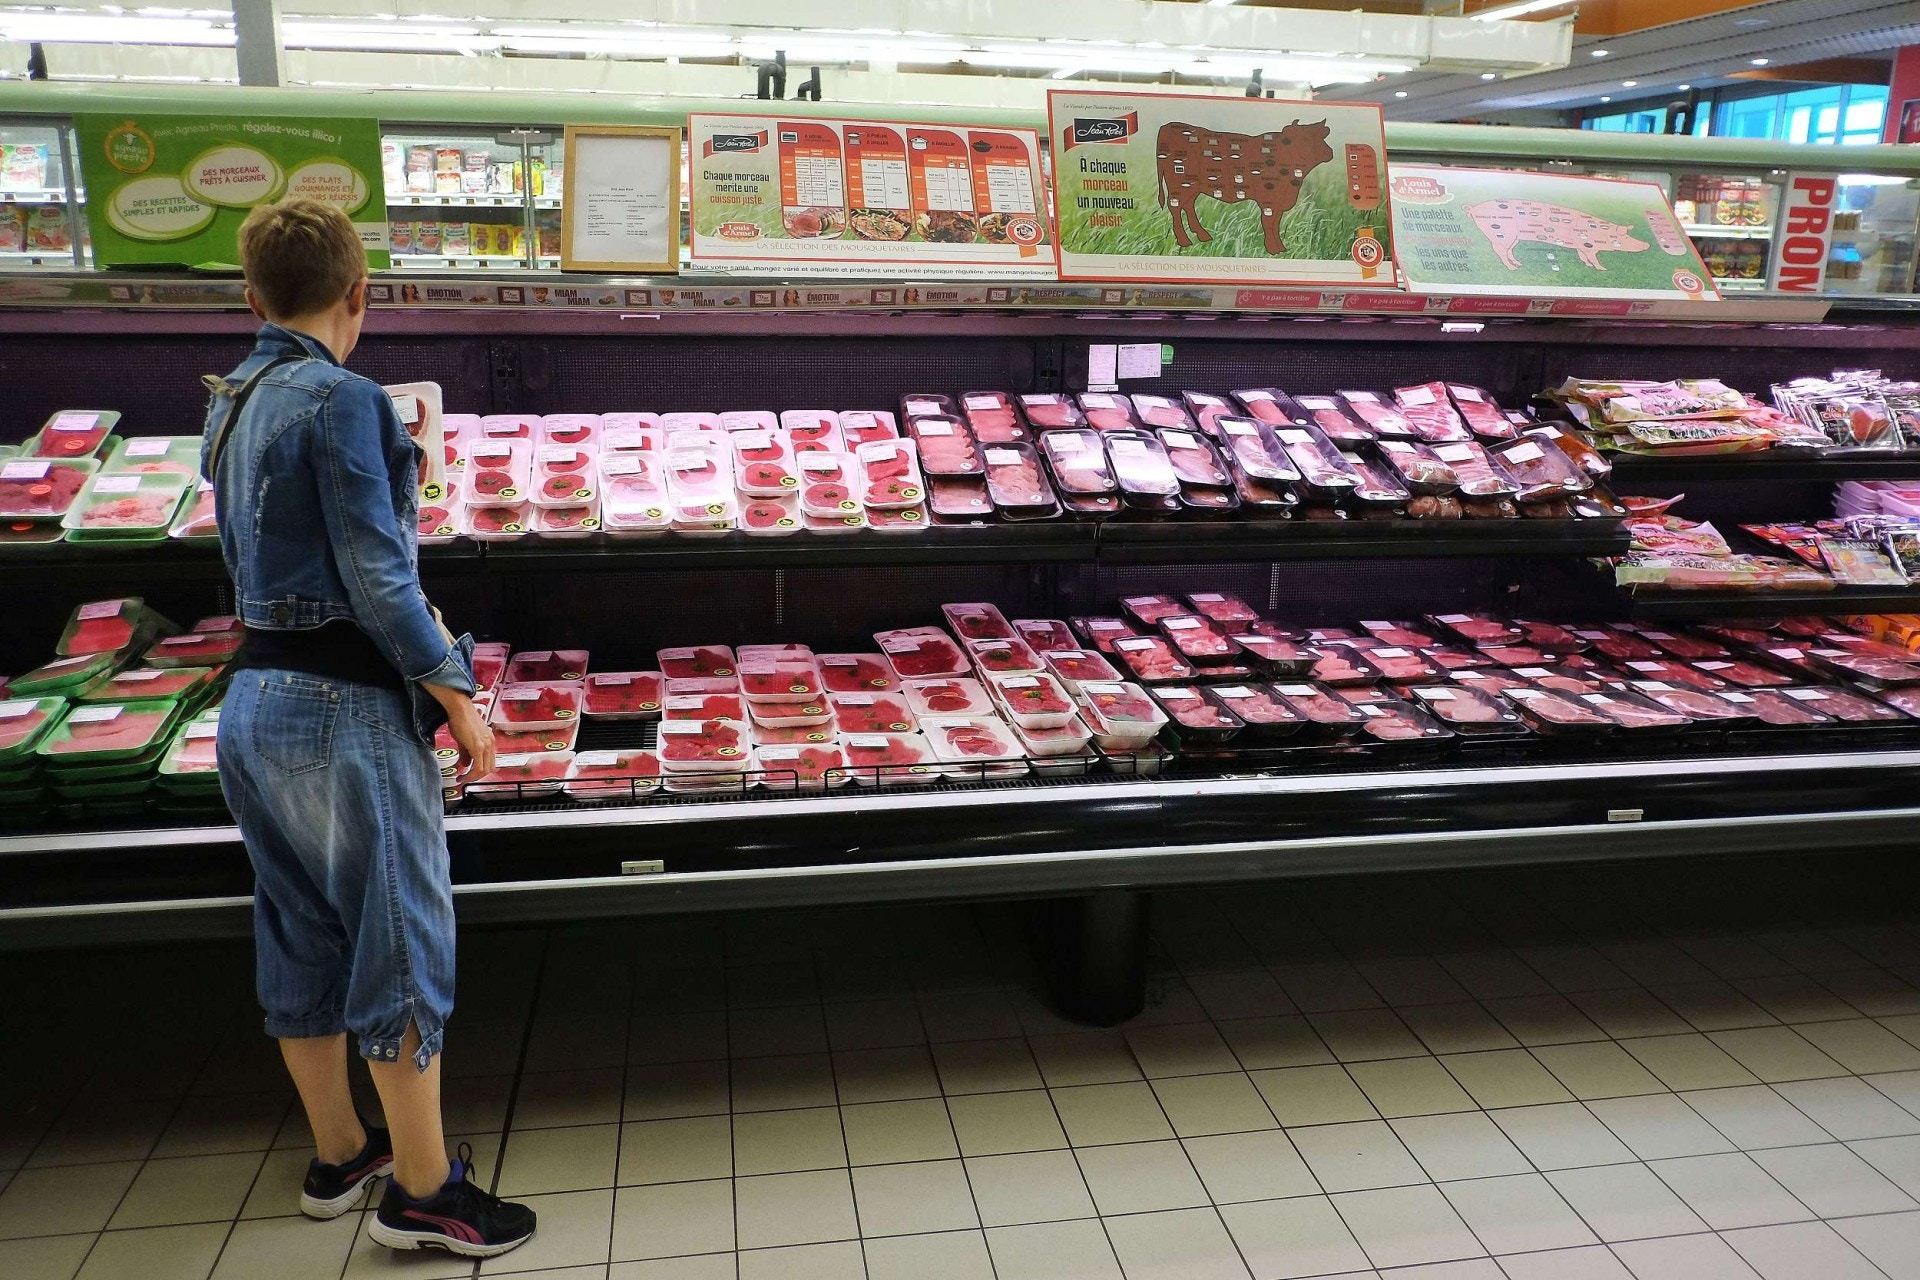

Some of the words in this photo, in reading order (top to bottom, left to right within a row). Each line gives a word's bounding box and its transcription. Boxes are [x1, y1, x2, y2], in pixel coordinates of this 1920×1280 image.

[243, 122, 310, 137] régalez-vous
[312, 128, 335, 143] illico
[202, 169, 217, 177] DES
[219, 166, 260, 175] MORCEAUX
[1090, 158, 1127, 176] chaque
[233, 174, 267, 183] CUISINER
[302, 176, 317, 184] DES
[318, 176, 342, 184] PLATS
[703, 170, 733, 182] Chaque
[734, 172, 770, 182] morceau
[294, 184, 341, 193] GOURMANDS
[1083, 179, 1128, 192] morceau
[1402, 179, 1432, 188] Louis
[744, 185, 759, 193] une
[1399, 186, 1441, 196] d'Armel
[150, 197, 187, 206] RECETTES
[710, 194, 741, 204] cuisson
[742, 195, 765, 206] juste.
[1077, 196, 1090, 208] un
[1092, 196, 1134, 209] nouveau
[123, 208, 155, 217] SIMPLES
[157, 207, 167, 215] ET
[168, 205, 200, 214] RAPIDES
[1401, 207, 1421, 219] Une
[1421, 208, 1455, 221] palette
[1090, 211, 1123, 228] plaisir.
[728, 224, 751, 232] Louis
[1402, 221, 1416, 231] de
[1416, 222, 1464, 233] morceaux
[756, 242, 769, 250] LA
[821, 243, 838, 251] DES
[840, 243, 915, 252] MOUSQUETAIRES
[1415, 245, 1431, 258] les
[1432, 248, 1450, 258] uns
[1450, 249, 1469, 260] que
[692, 263, 709, 271] Pour
[753, 265, 780, 273] mangez
[1118, 262, 1130, 270] LA
[1179, 263, 1194, 271] DES
[1195, 264, 1266, 273] MOUSQUETAIRES
[1421, 259, 1437, 271] les
[1438, 260, 1473, 272] autres.
[555, 289, 578, 298] MIAM
[680, 291, 704, 300] MIAM
[567, 297, 591, 306] MIAM
[693, 299, 716, 307] MIAM
